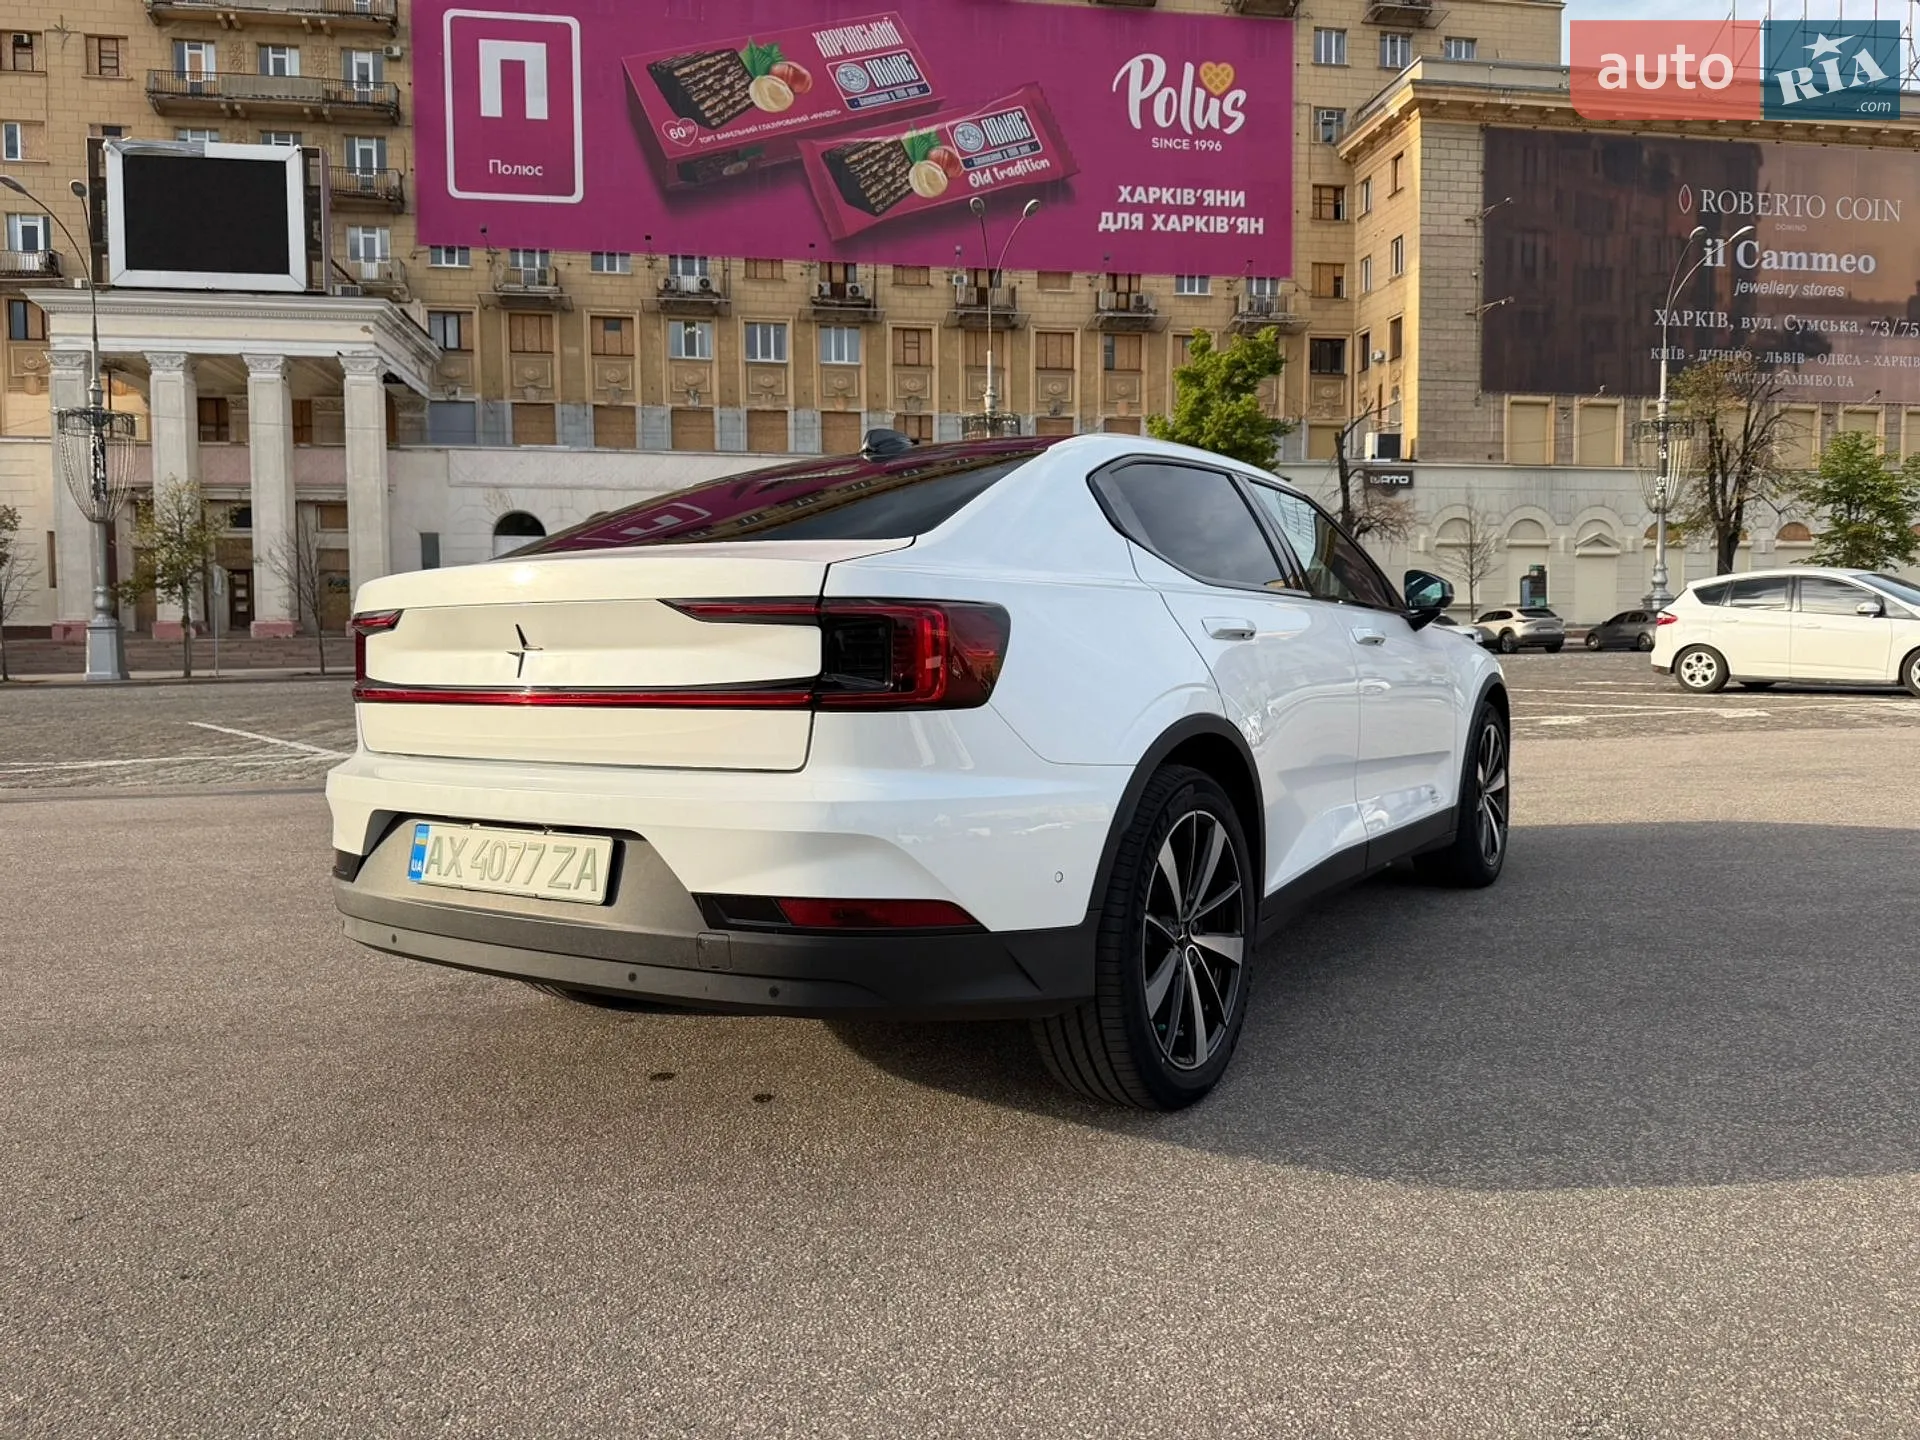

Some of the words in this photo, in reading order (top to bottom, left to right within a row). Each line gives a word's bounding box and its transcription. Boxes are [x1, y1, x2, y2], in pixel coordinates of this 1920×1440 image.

[864, 54, 919, 88] ПОЛЮС
[1112, 53, 1247, 135] Polus
[981, 111, 1031, 147] ПОЛЮС
[1152, 137, 1190, 150] SINCE
[1194, 139, 1222, 152] 1996
[488, 158, 543, 177] Полюс
[968, 169, 994, 188] Old
[994, 158, 1050, 181] tradition
[1699, 188, 1826, 219] ROBERTO
[1835, 196, 1903, 222] COIN
[1098, 211, 1144, 232] ДЛЯ
[1703, 238, 1726, 267] il
[1735, 240, 1876, 275] Cammeo
[1734, 279, 1799, 298] jewellery
[1802, 281, 1845, 297] stores
[1654, 308, 1735, 331] ХАРКІВ,
[1740, 316, 1777, 333] вул.
[1783, 314, 1865, 336] Сумська,
[1870, 319, 1919, 338] 73/75
[1764, 352, 1805, 364] ЛЬВІВ
[1817, 353, 1861, 366] ОДЕСА
[411, 858, 423, 872] UA
[425, 836, 468, 878] AX
[469, 838, 546, 886] 4077
[547, 846, 597, 892] ZA
